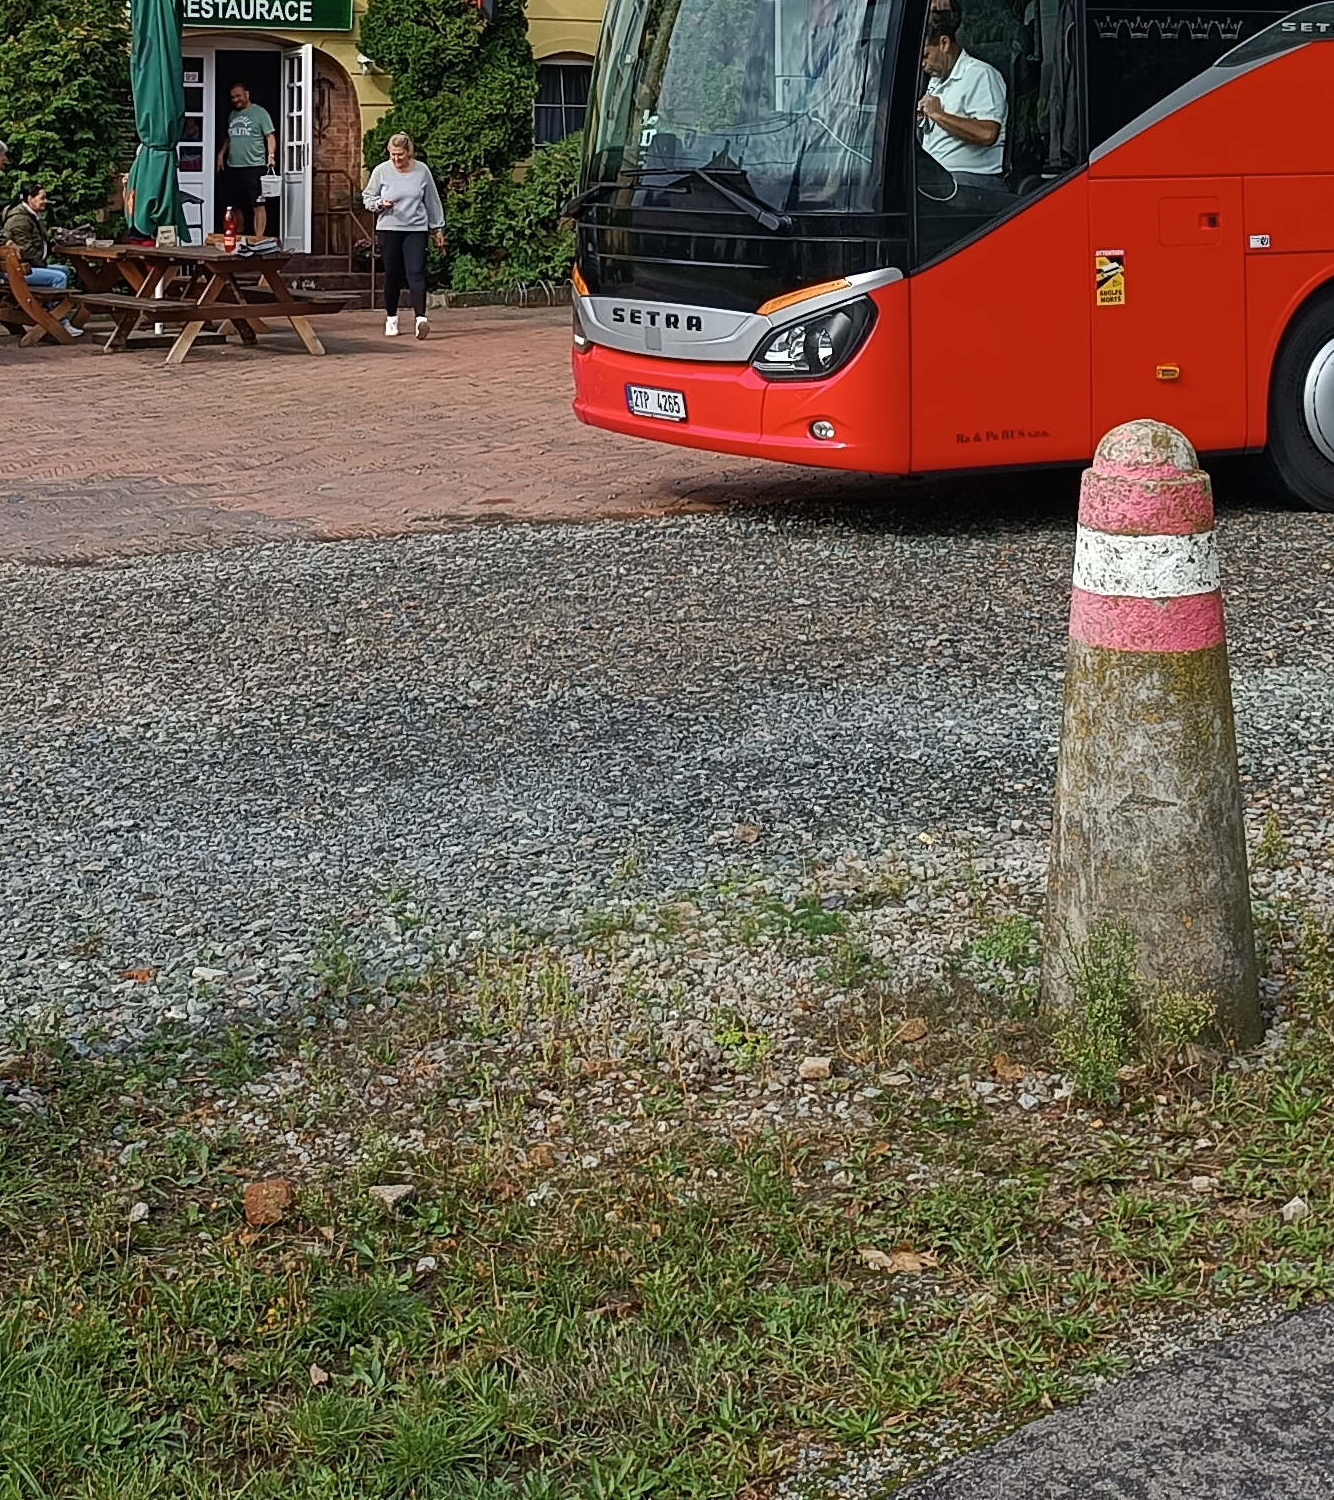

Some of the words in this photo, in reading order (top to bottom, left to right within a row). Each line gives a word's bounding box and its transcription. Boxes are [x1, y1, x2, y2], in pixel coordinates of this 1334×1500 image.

[612, 307, 702, 332] SETRA
[633, 389, 649, 410] 2TP
[657, 393, 681, 414] 4265
